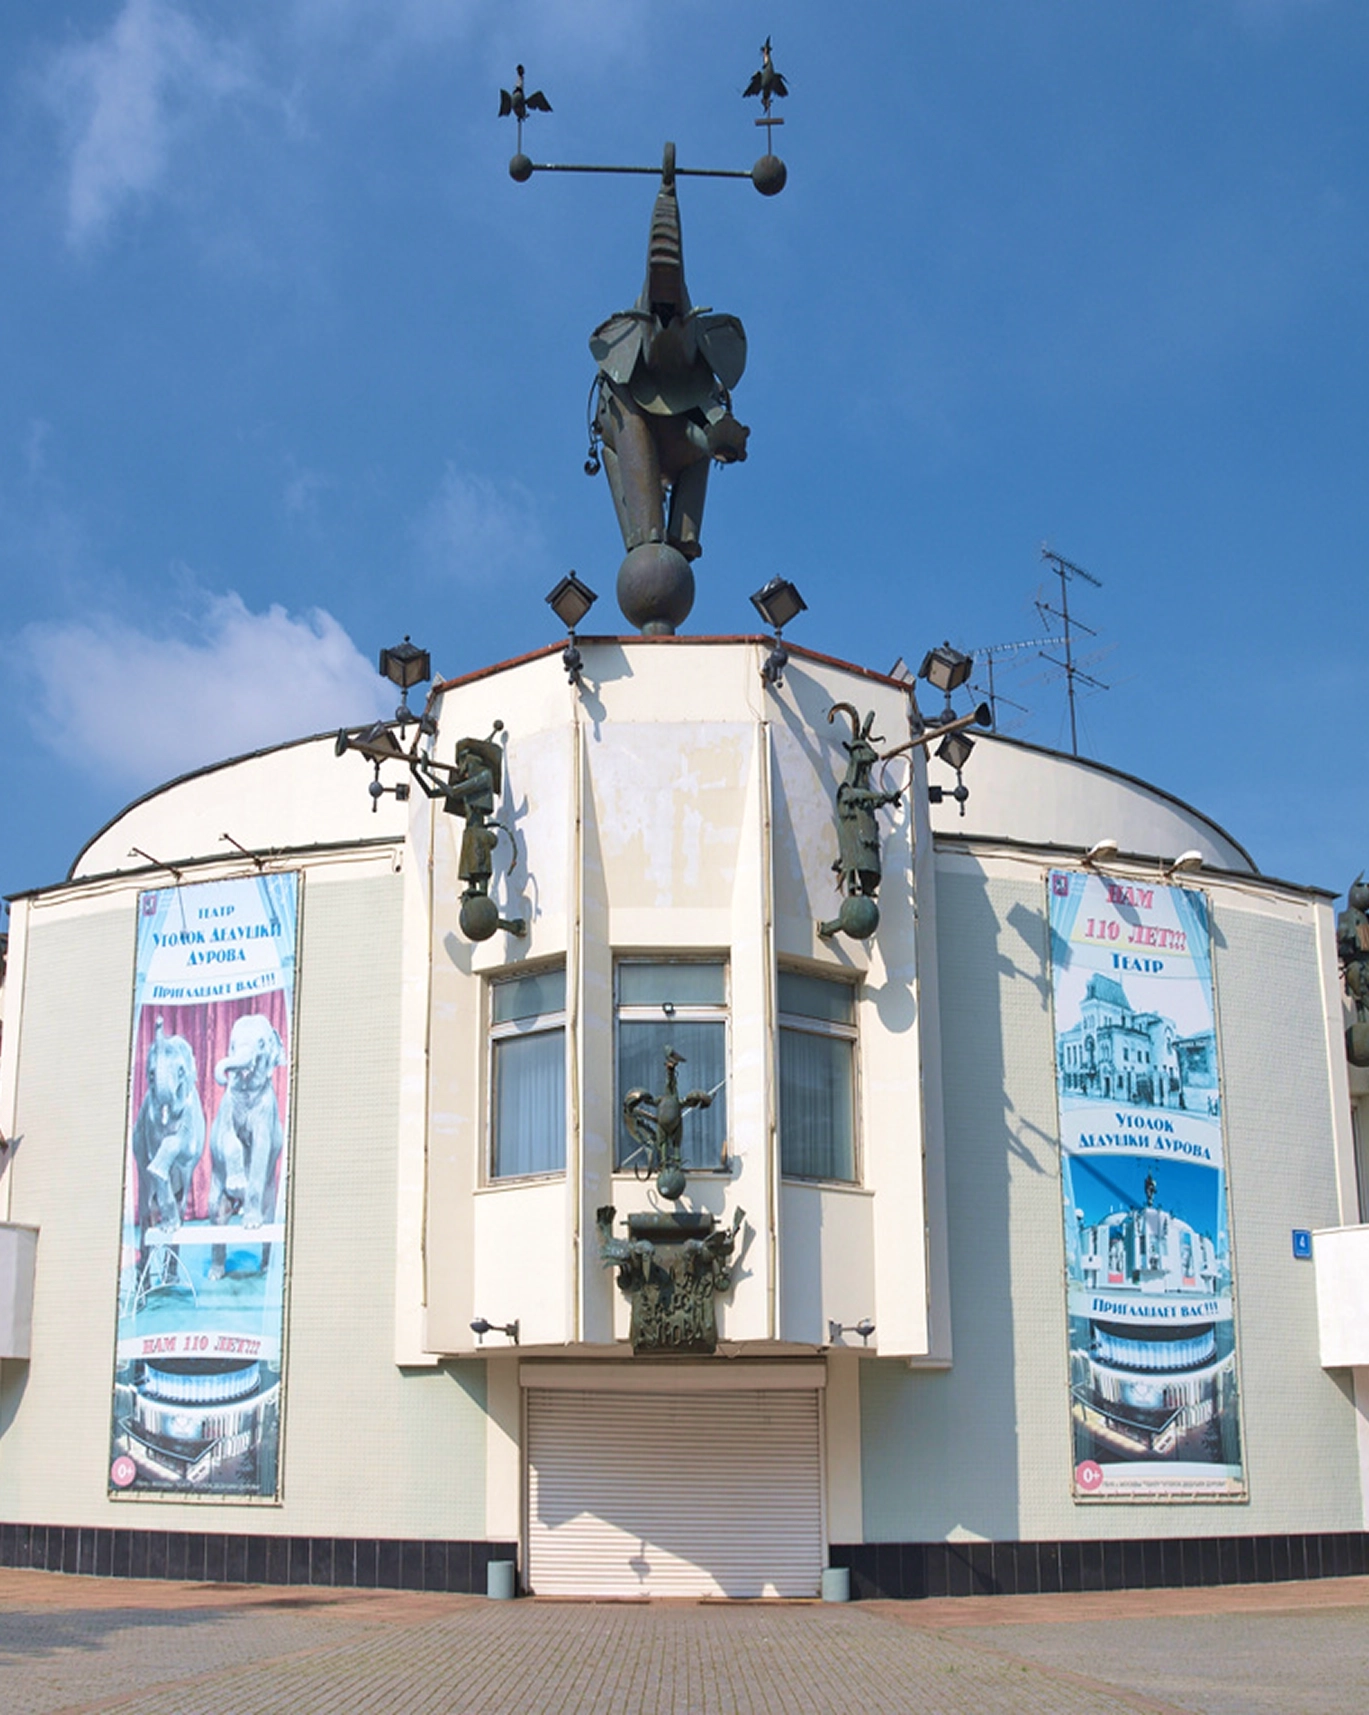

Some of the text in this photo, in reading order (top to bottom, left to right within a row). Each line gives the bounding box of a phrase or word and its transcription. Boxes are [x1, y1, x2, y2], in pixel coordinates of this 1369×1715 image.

[1107, 884, 1153, 909] НАМ
[198, 905, 235, 919] ТЕАТР
[152, 923, 281, 948] УГОЛОК ДЕДУШКИ
[1085, 918, 1187, 951] 110 ЛЕТ!!!
[187, 949, 246, 966] ДУРОВА
[1113, 953, 1163, 972] ТЕАТР
[152, 984, 231, 998] ПРИГЛАШАЕТ
[1115, 1112, 1175, 1133] УГОЛОК
[1078, 1133, 1211, 1160] ДЕДУШКИ ДУРОВА
[1299, 1235, 1306, 1248] 4
[1092, 1299, 1177, 1318] ПРИГЛАШАЕТ
[142, 1336, 261, 1355] НАМ 110 ЛЕТ!!!
[117, 1466, 133, 1478] 0+
[1082, 1467, 1100, 1483] 0+
